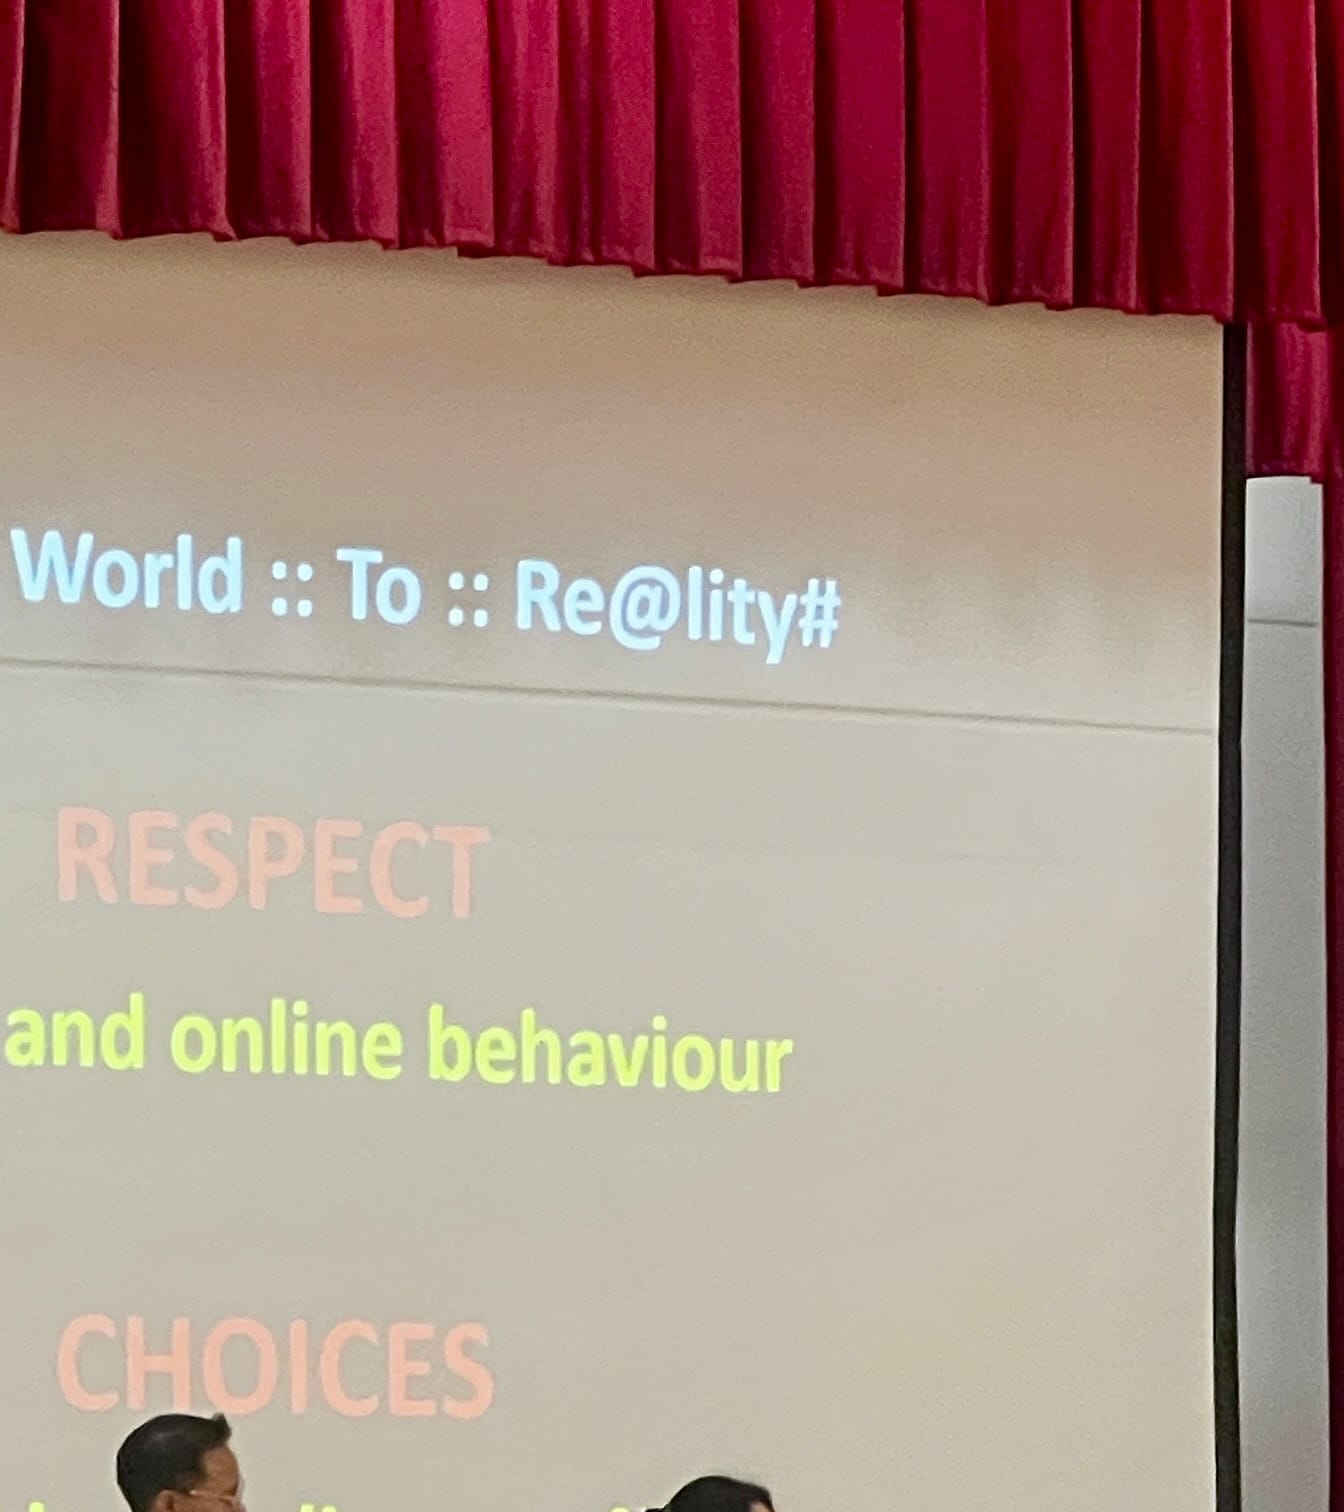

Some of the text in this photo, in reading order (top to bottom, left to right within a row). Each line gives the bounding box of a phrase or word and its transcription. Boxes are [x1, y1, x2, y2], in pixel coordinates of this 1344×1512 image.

[10, 527, 245, 615] World
[270, 560, 315, 617] ::
[338, 547, 424, 626] To
[449, 573, 490, 627] ::
[515, 557, 843, 665] Re@lity#
[56, 804, 492, 920] RESPECT
[5, 992, 146, 1070] and
[170, 999, 403, 1080] online
[428, 1003, 794, 1093] behaviour
[56, 1313, 495, 1418] CHOICES
